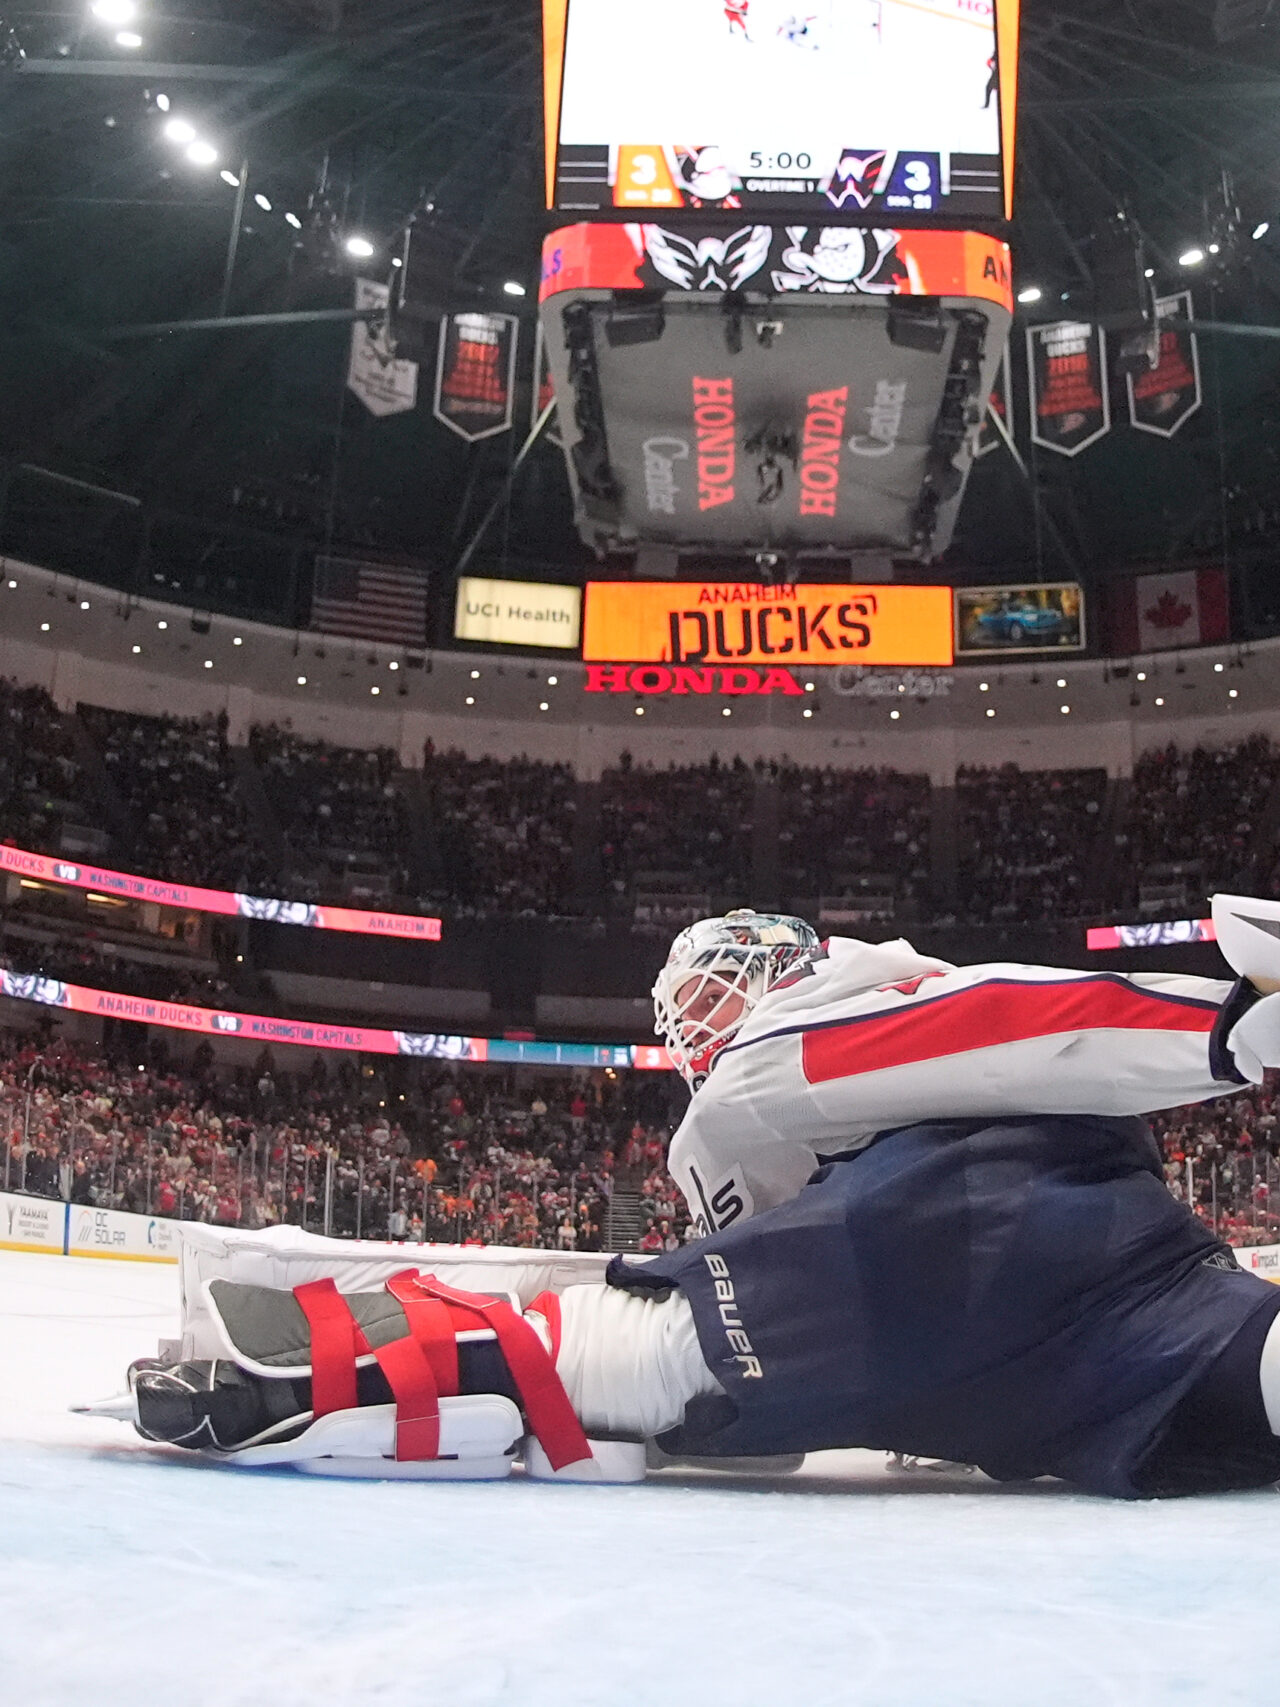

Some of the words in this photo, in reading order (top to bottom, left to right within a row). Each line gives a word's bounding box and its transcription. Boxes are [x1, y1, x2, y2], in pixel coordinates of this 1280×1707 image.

[630, 155, 656, 184] 3
[750, 152, 811, 169] 5:00
[904, 161, 931, 191] 3
[746, 179, 805, 194] OVERTIME
[848, 379, 907, 456] Center
[693, 376, 735, 512] HONDA
[800, 386, 849, 517] HONDA
[642, 436, 690, 514] Center
[466, 602, 500, 618] UCI
[508, 605, 570, 625] Health
[699, 584, 798, 605] ANAHEIM
[669, 602, 873, 661] DUCKS
[584, 665, 804, 695] HONDA
[832, 665, 954, 696] Center
[6, 851, 45, 873] DUCKS
[90, 873, 145, 893] WASHINGTON
[147, 885, 188, 902] CAPITALS
[368, 918, 424, 933] ANAHEIM
[97, 996, 156, 1017] ANAHEIM
[160, 1007, 202, 1026] DUCKS
[217, 1015, 238, 1031] VS
[252, 1021, 313, 1040] WASHINGTON
[316, 1028, 363, 1045] CAPITALS
[95, 1228, 126, 1246] SOLAR
[704, 1254, 764, 1379] BAUER
